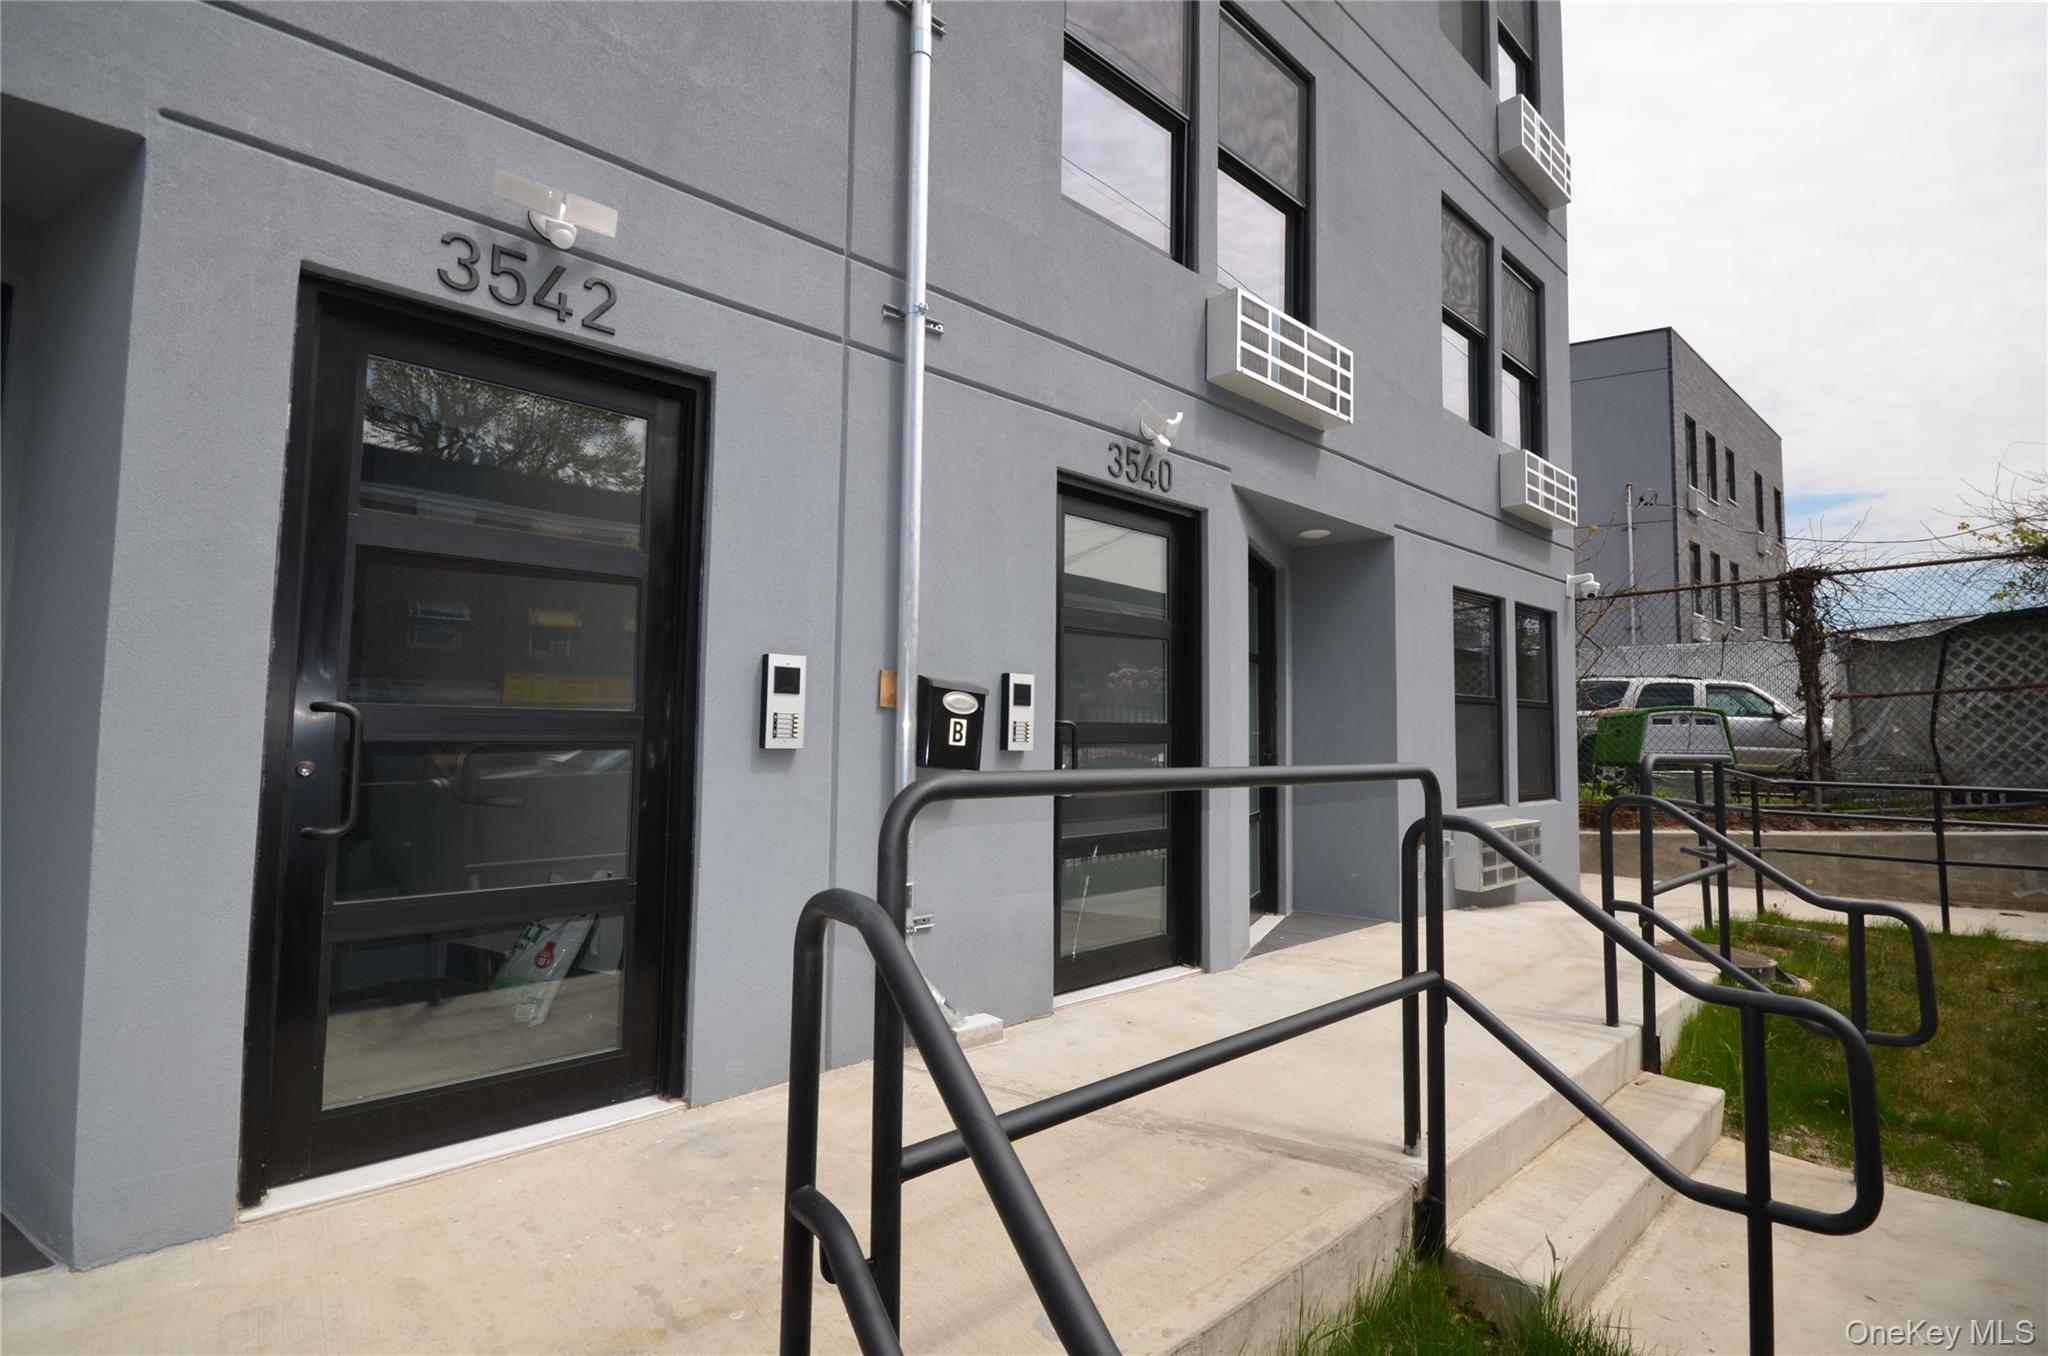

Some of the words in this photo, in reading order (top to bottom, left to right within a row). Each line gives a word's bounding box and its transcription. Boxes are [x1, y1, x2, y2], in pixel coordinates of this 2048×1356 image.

[437, 231, 618, 336] 3542
[1107, 441, 1173, 493] 3540
[951, 720, 964, 743] B
